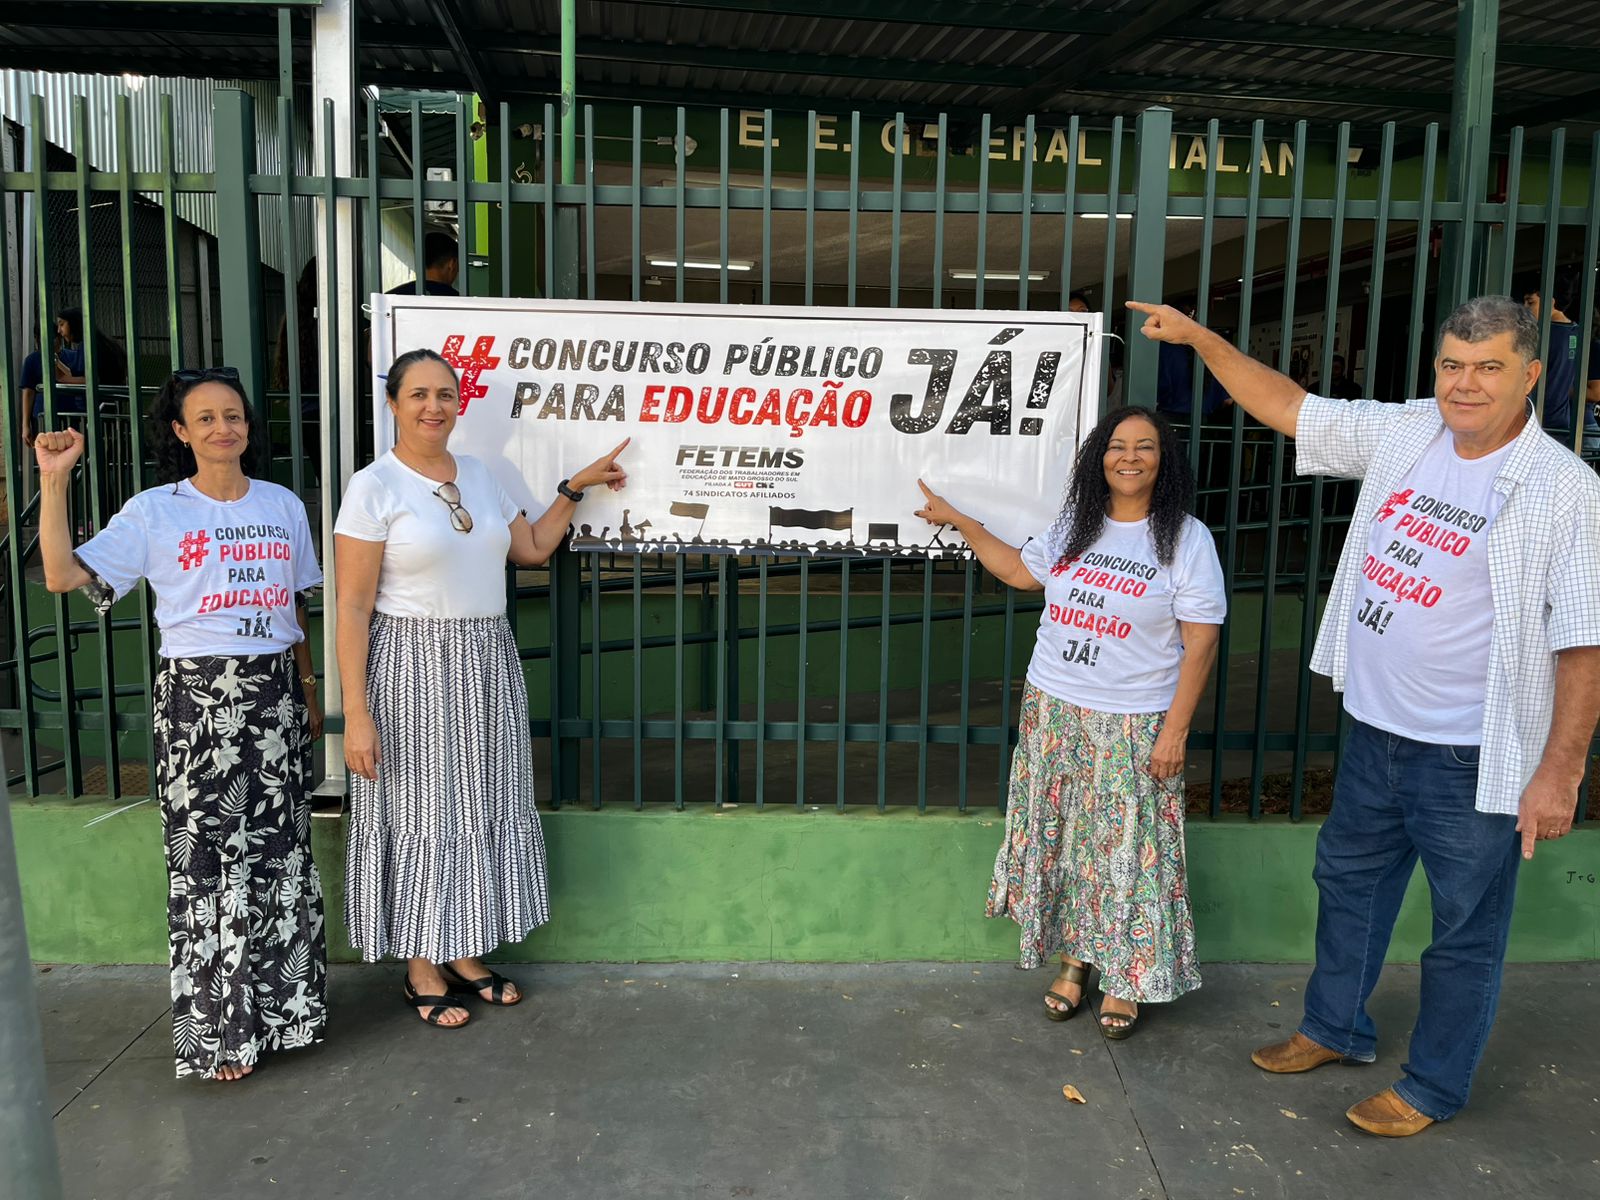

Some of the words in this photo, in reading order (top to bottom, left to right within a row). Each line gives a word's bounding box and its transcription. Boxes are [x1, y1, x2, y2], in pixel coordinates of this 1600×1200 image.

[738, 109, 780, 148] E.
[814, 114, 852, 152] E.
[880, 119, 1103, 166] GERAL
[507, 337, 711, 375] CONCURSO
[722, 336, 884, 379] PÚBLICO
[889, 327, 1062, 436] JÁ!
[510, 381, 626, 422] PARA
[638, 380, 873, 438] EDUCAÇÃO
[675, 444, 804, 469] FETEMS
[683, 489, 693, 497] 74
[695, 489, 748, 498] SINDICATOS
[750, 491, 796, 499] AFILIADOS
[1411, 494, 1487, 533] CONCURSO
[214, 524, 290, 541] CONCURSO
[1393, 513, 1471, 557] PÚBLICO
[219, 541, 291, 563] PÚBLICO
[1083, 552, 1158, 581] CONCURSO
[1384, 539, 1424, 569] PARA
[228, 566, 266, 584] PARA
[1071, 567, 1148, 598] PÚBLICO
[1362, 554, 1443, 608] DUCAÇÃO
[197, 583, 290, 614] EDUCAÇÃO
[1068, 587, 1106, 610] PARA
[236, 610, 274, 639] JÁ!
[1357, 597, 1394, 635] JÁ!
[1062, 637, 1100, 667] JÁ!
